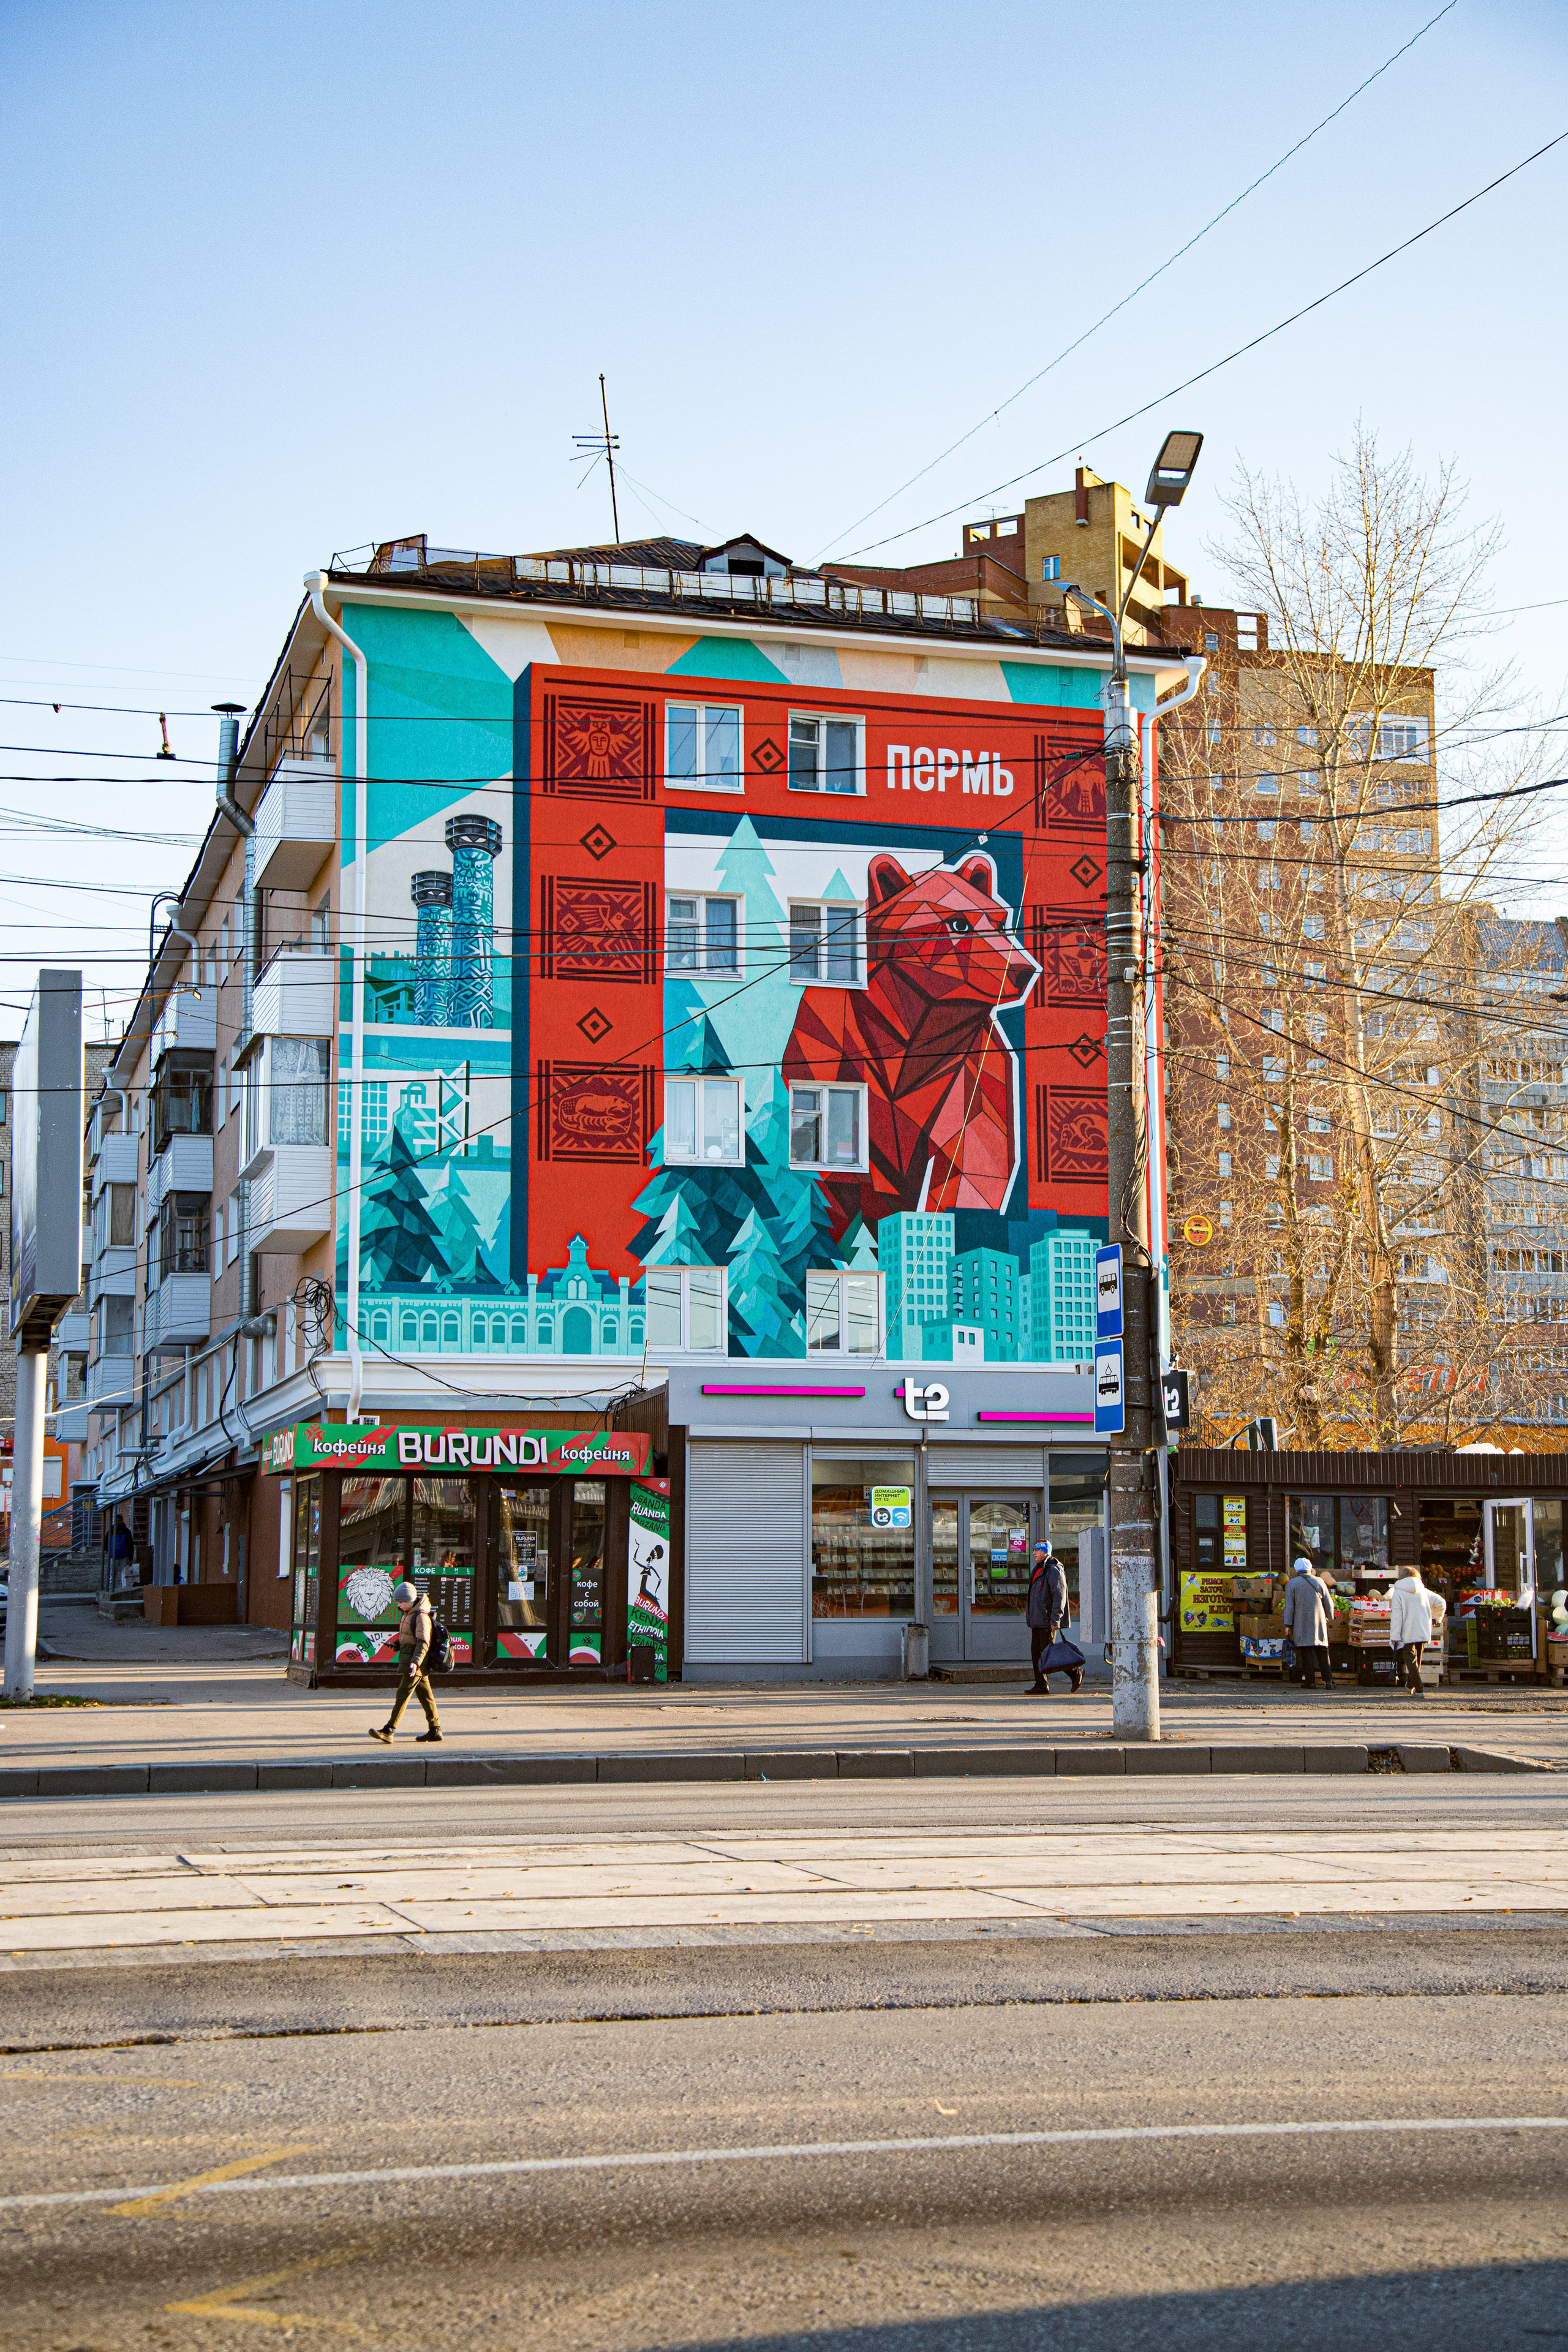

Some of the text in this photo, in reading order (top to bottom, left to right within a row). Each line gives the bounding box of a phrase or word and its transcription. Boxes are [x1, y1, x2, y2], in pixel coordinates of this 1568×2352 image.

[903, 1377, 949, 1420] t2
[1164, 1385, 1180, 1419] t2
[313, 1431, 630, 1467] кофейня BURUNDI кофейня
[631, 1502, 666, 1518] RUANDA
[632, 1493, 665, 1510] UGANDA
[632, 1514, 665, 1532] TANZANIA
[877, 1511, 888, 1522] t2
[577, 1580, 598, 1589] кофе
[631, 1606, 664, 1630] KENYA
[346, 1632, 383, 1660] BURUNDI
